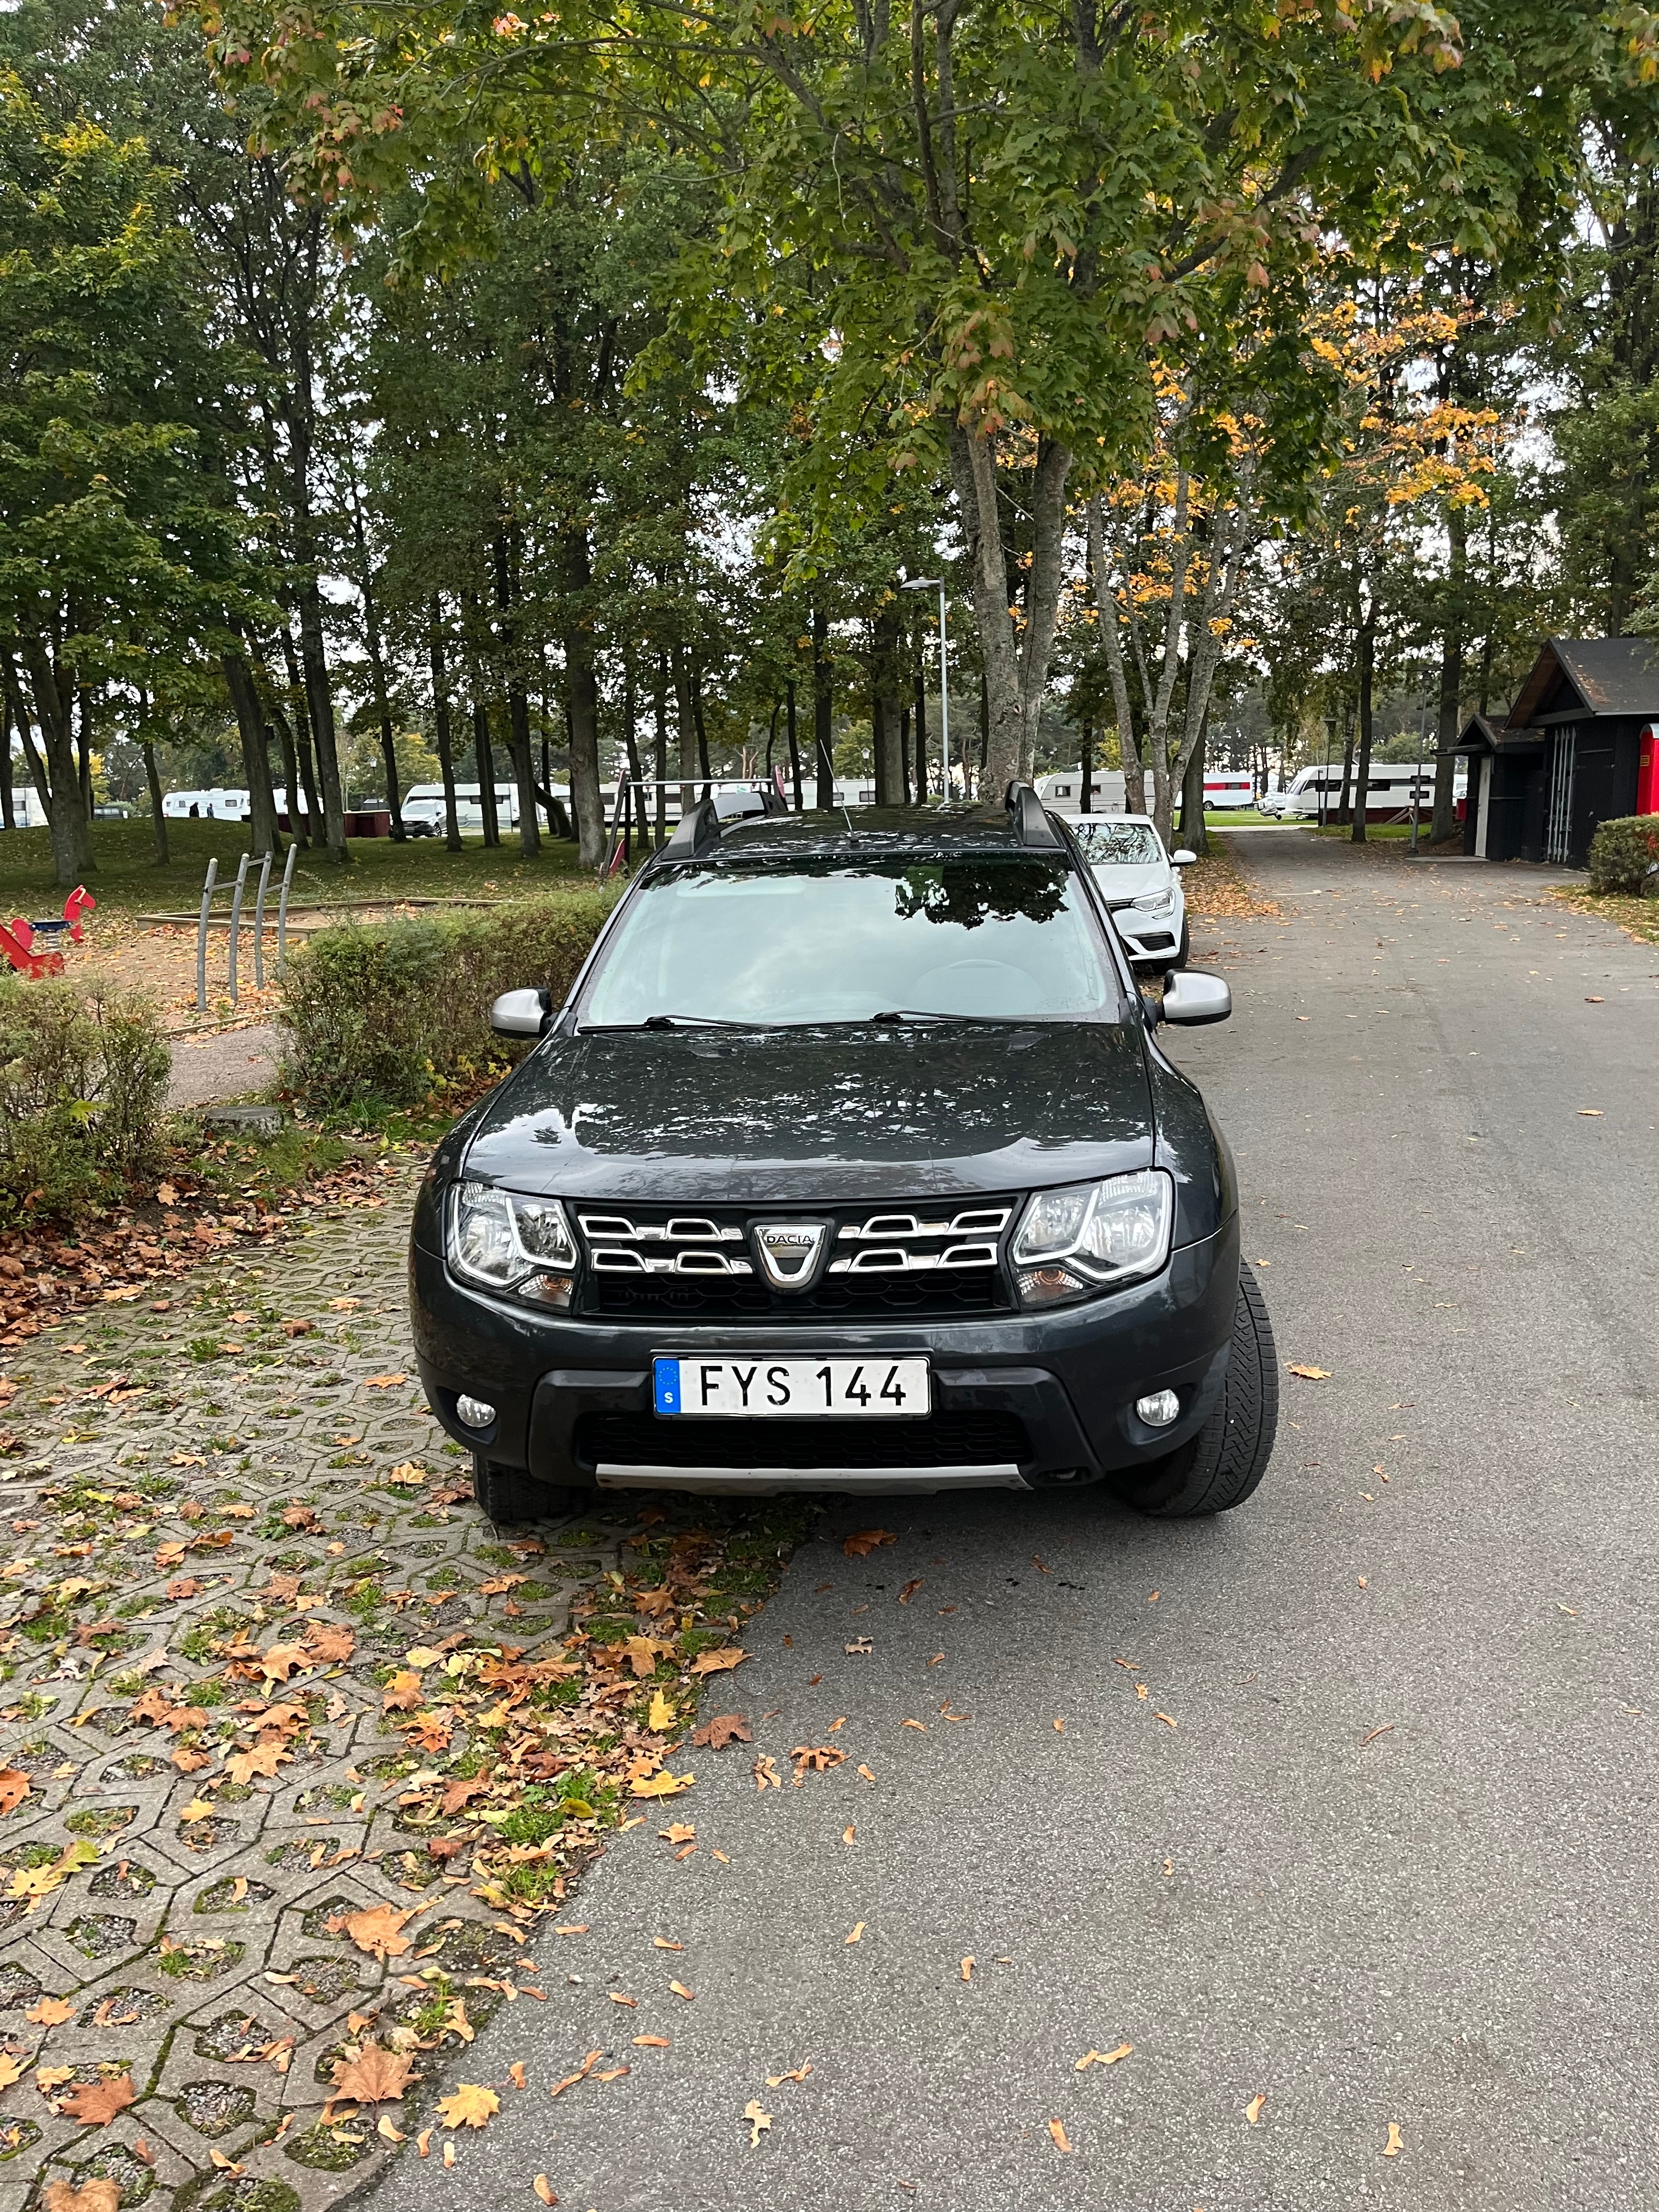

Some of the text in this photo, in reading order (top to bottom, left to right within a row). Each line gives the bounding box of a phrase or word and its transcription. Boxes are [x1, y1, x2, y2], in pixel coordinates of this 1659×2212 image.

[766, 1235, 813, 1244] DACIA
[700, 1365, 906, 1407] FYS 144
[664, 1392, 673, 1403] S
